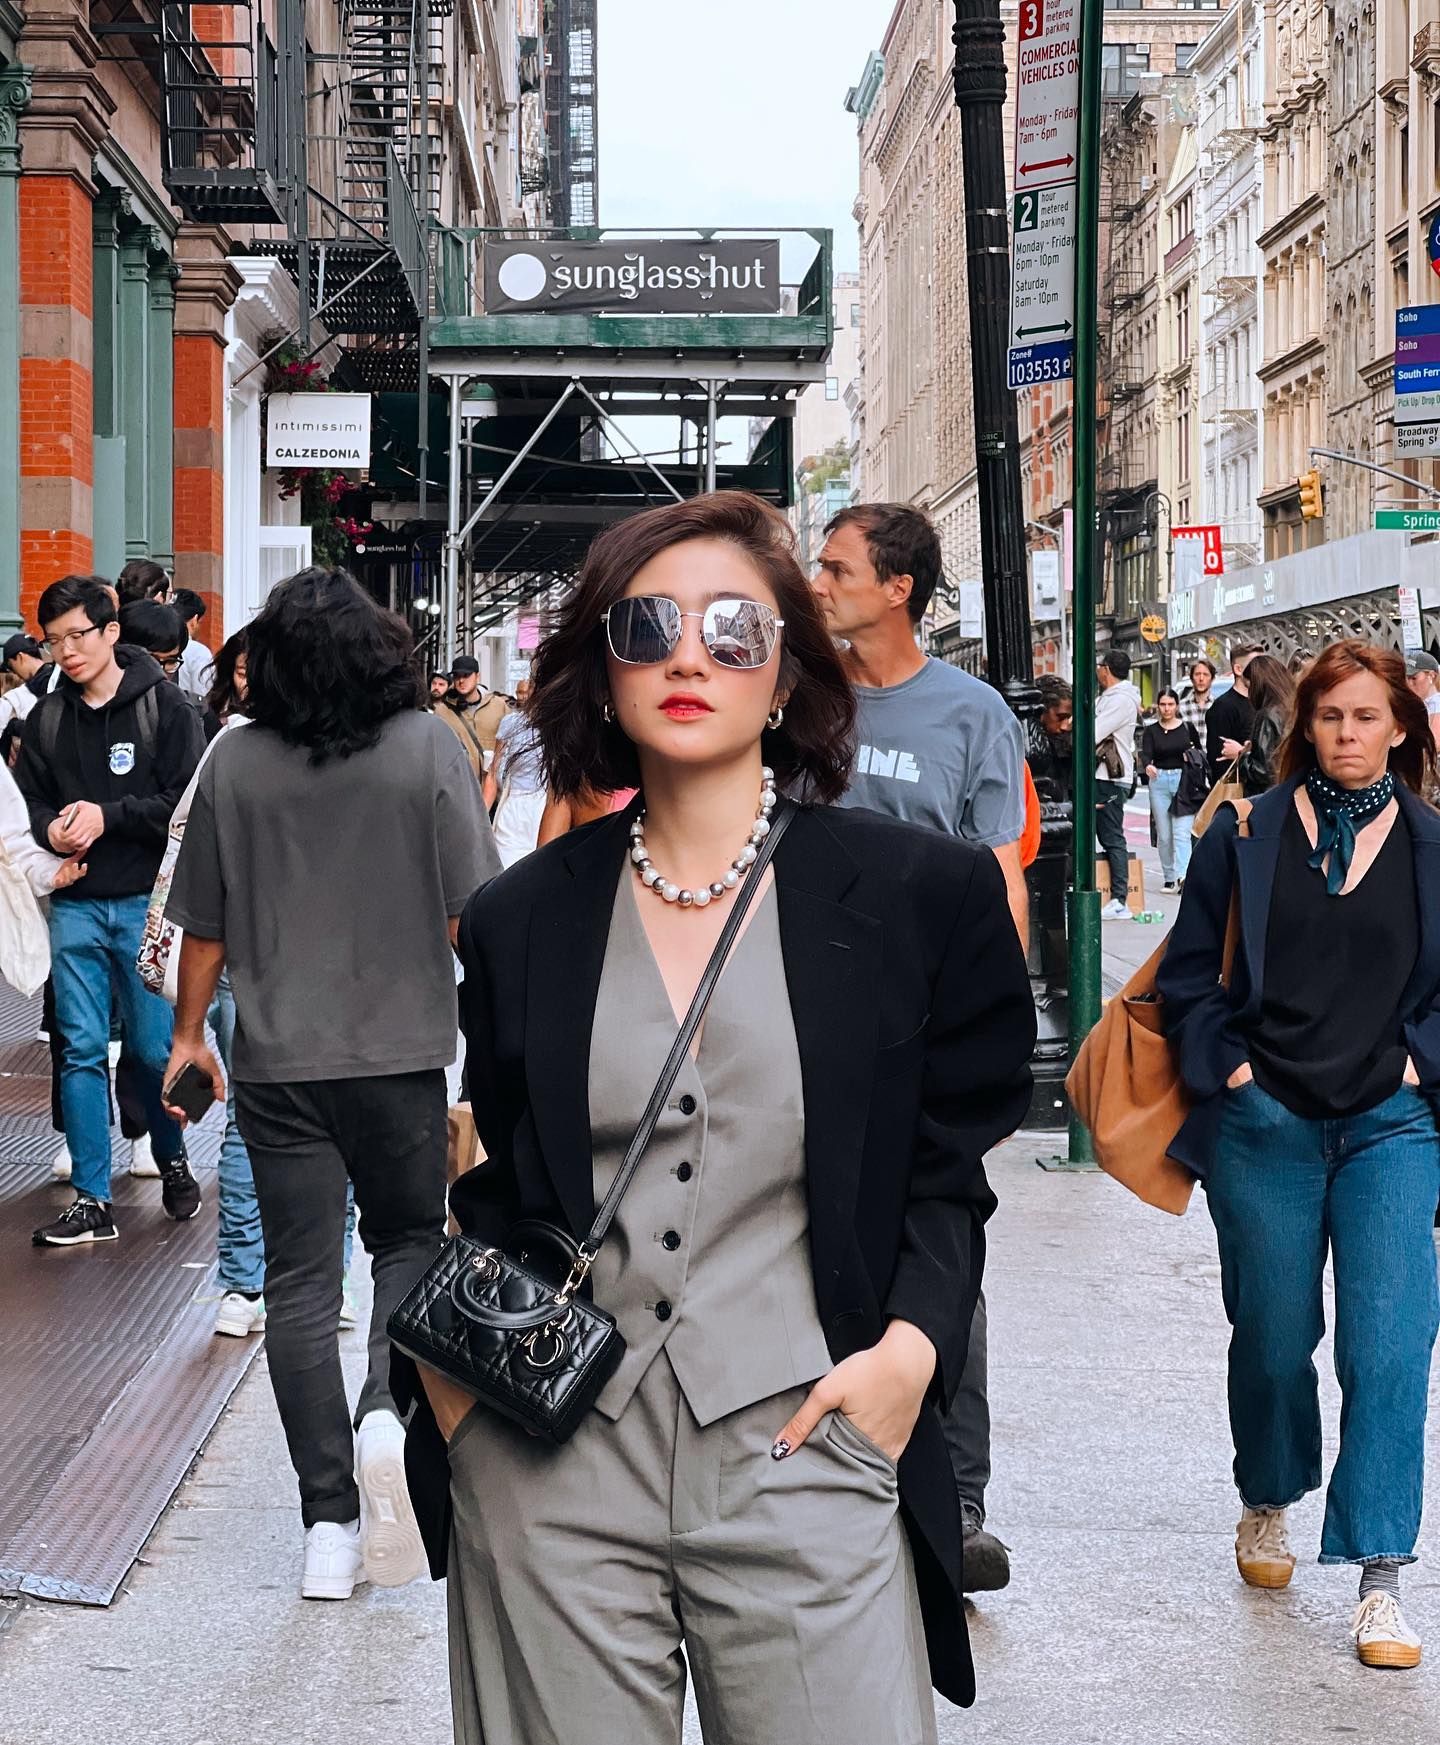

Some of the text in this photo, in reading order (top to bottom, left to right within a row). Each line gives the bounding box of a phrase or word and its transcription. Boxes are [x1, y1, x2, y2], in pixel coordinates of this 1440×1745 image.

[1024, 3, 1038, 36] 3
[1046, 7, 1073, 22] metered
[1046, 22, 1070, 37] parking
[1021, 38, 1080, 66] COMMERCIAL
[1021, 61, 1065, 85] VEHICLES
[1019, 113, 1047, 129] Monday
[1054, 106, 1078, 121] Friday
[1019, 132, 1034, 144] 7am
[1041, 128, 1057, 142] 6pm
[1041, 192, 1056, 203] hour
[1020, 195, 1033, 229] 2
[1041, 201, 1069, 215] metered
[1041, 216, 1065, 230] parking
[1016, 240, 1044, 255] Monday
[1051, 235, 1075, 249] Friday
[1015, 258, 1033, 272] 6pm
[1039, 253, 1060, 267] 10pm
[555, 255, 766, 300] sunglass hut
[1015, 278, 1049, 292] Saturday
[1015, 296, 1032, 308] 8am
[1038, 292, 1059, 305] 10pm
[1398, 312, 1418, 323] Soho
[1398, 341, 1418, 351] Soho
[1011, 349, 1033, 360] Zone#
[1011, 357, 1060, 384] 103553
[1398, 369, 1421, 380] South
[275, 421, 362, 432] intimissimi
[1397, 426, 1439, 438] Broadway
[1397, 438, 1425, 448] Spring
[275, 447, 361, 459] CALZEDONIA
[857, 744, 921, 783] INE
